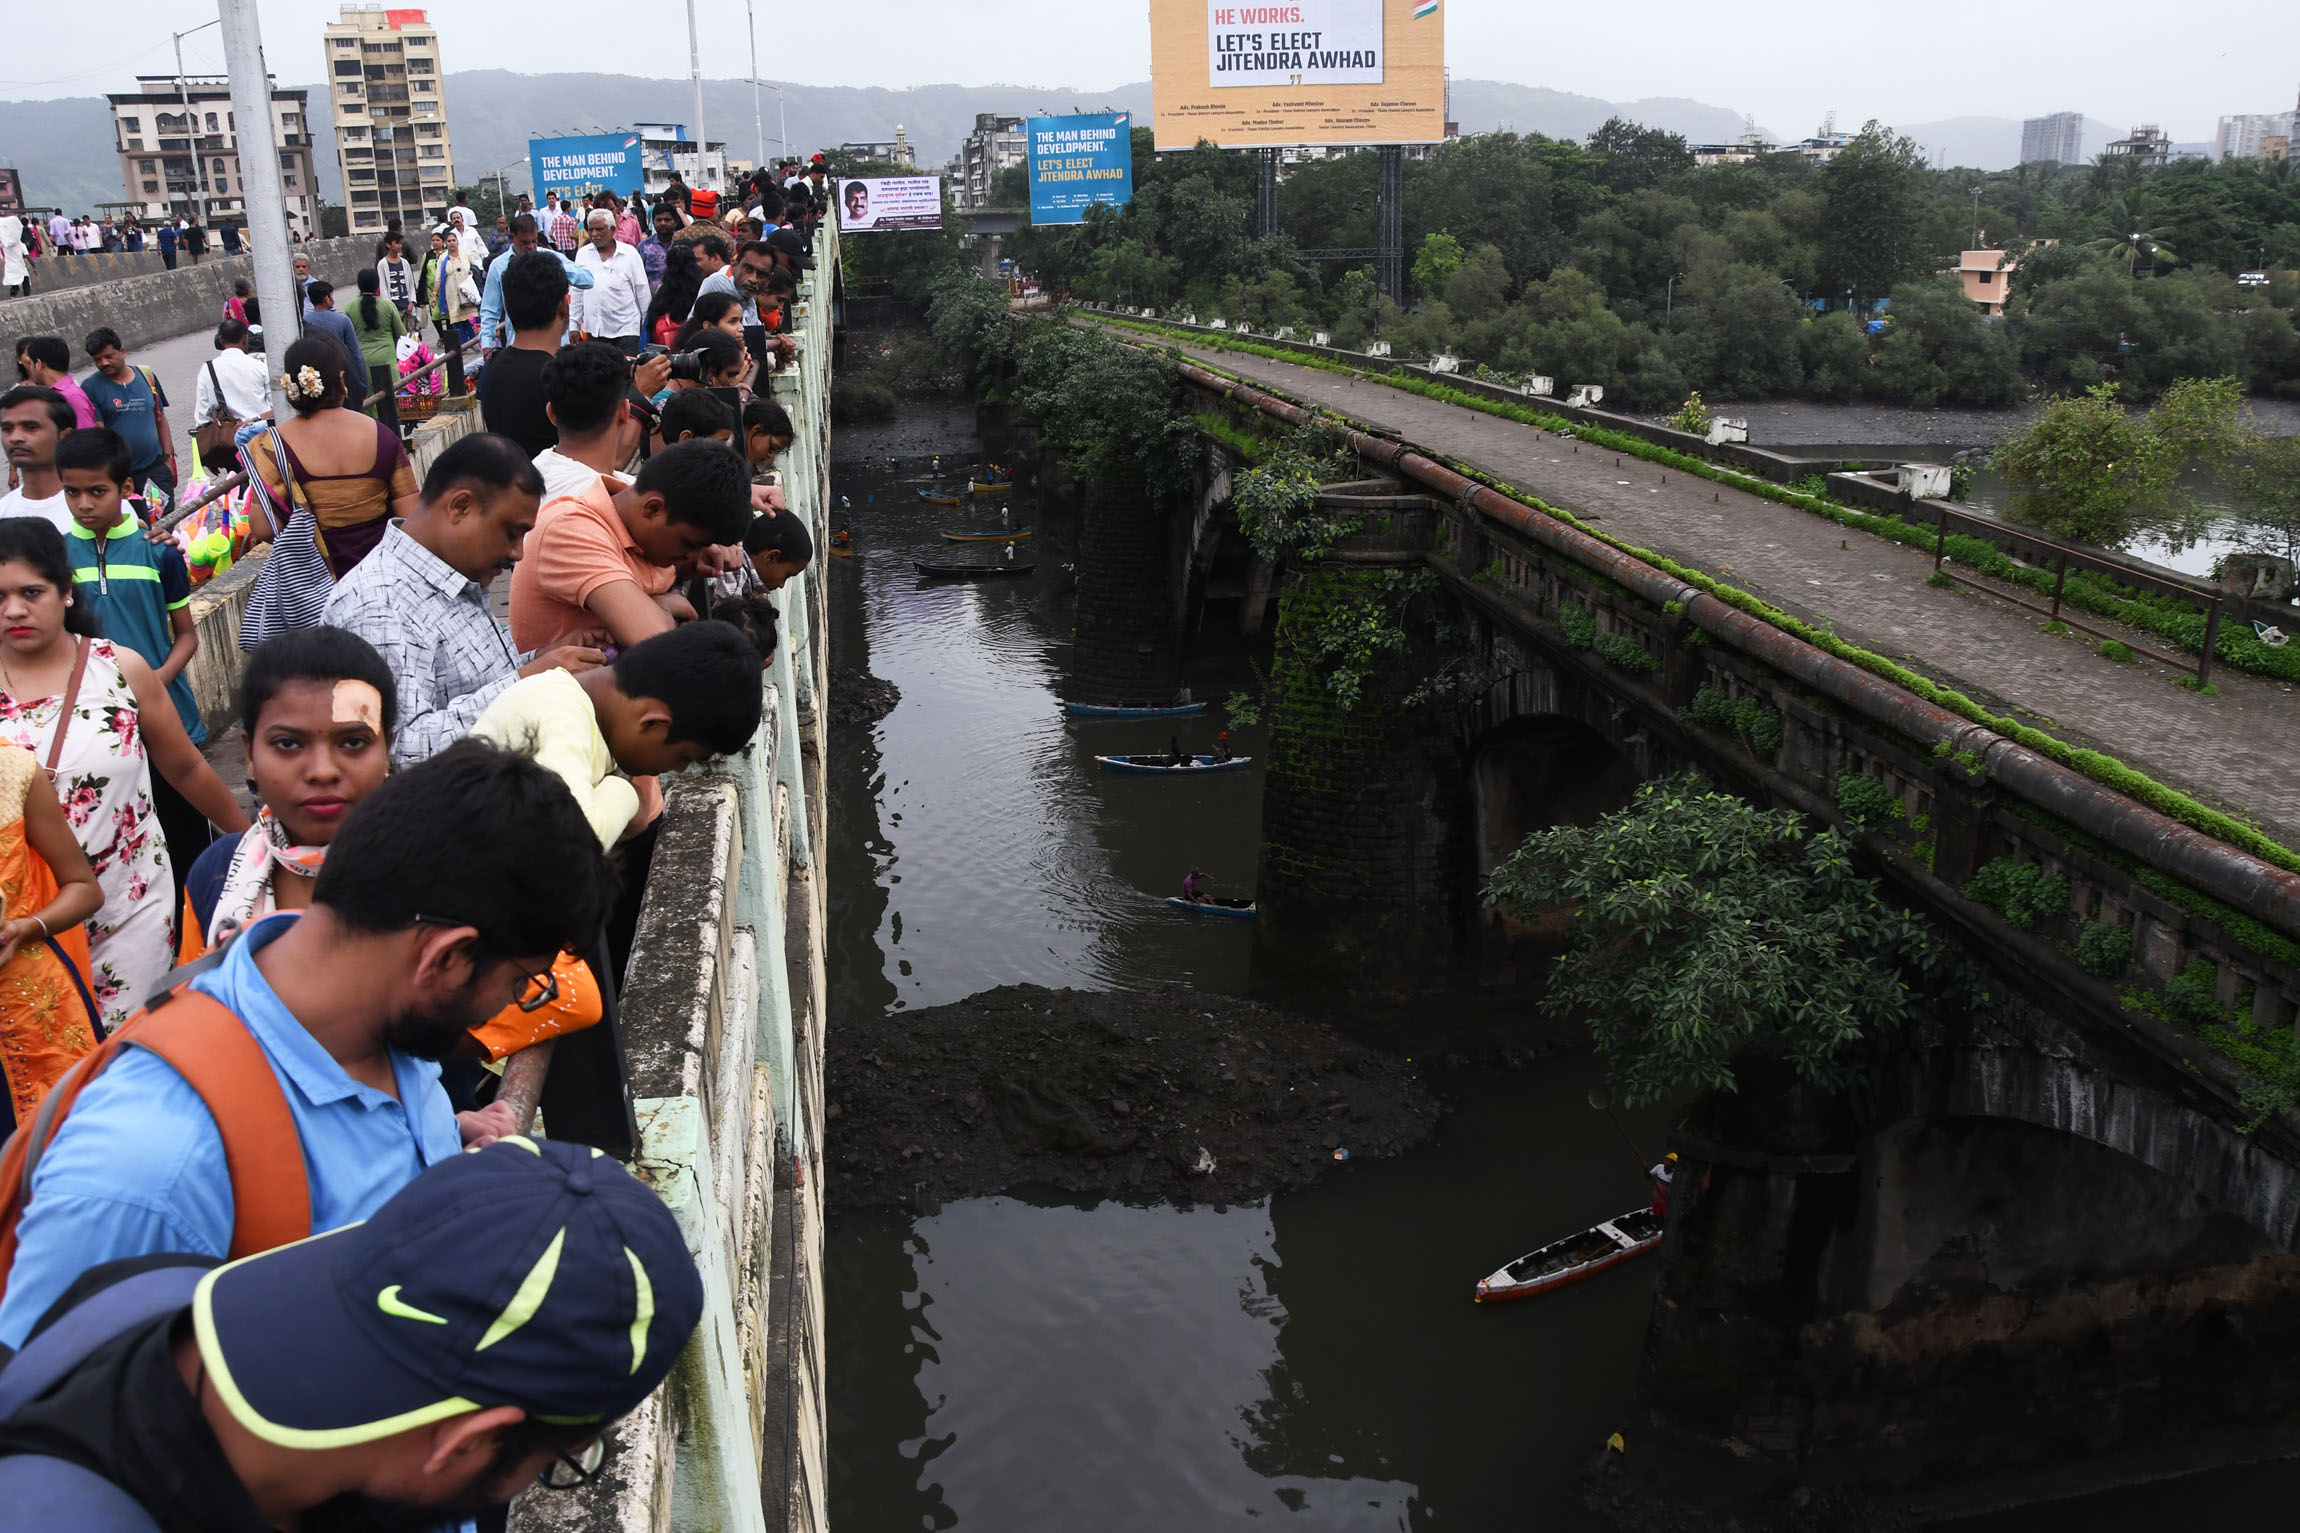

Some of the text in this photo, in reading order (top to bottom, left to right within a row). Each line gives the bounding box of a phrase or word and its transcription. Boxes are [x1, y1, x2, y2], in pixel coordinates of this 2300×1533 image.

[1215, 7, 1304, 25] HE WORKS.
[1217, 32, 1322, 52] LET'S ELECT
[1217, 51, 1376, 71] JITENDRA AWHAD
[1037, 129, 1115, 143] THE MAN BEHIND
[1038, 142, 1107, 154] DEVELOPMENT.
[542, 152, 625, 168] THE MAN BEHIND
[1038, 158, 1093, 170] LET'S ELECT
[544, 166, 617, 181] DEVELOPMENT.
[1039, 168, 1123, 182] JITENDRA AWHAD
